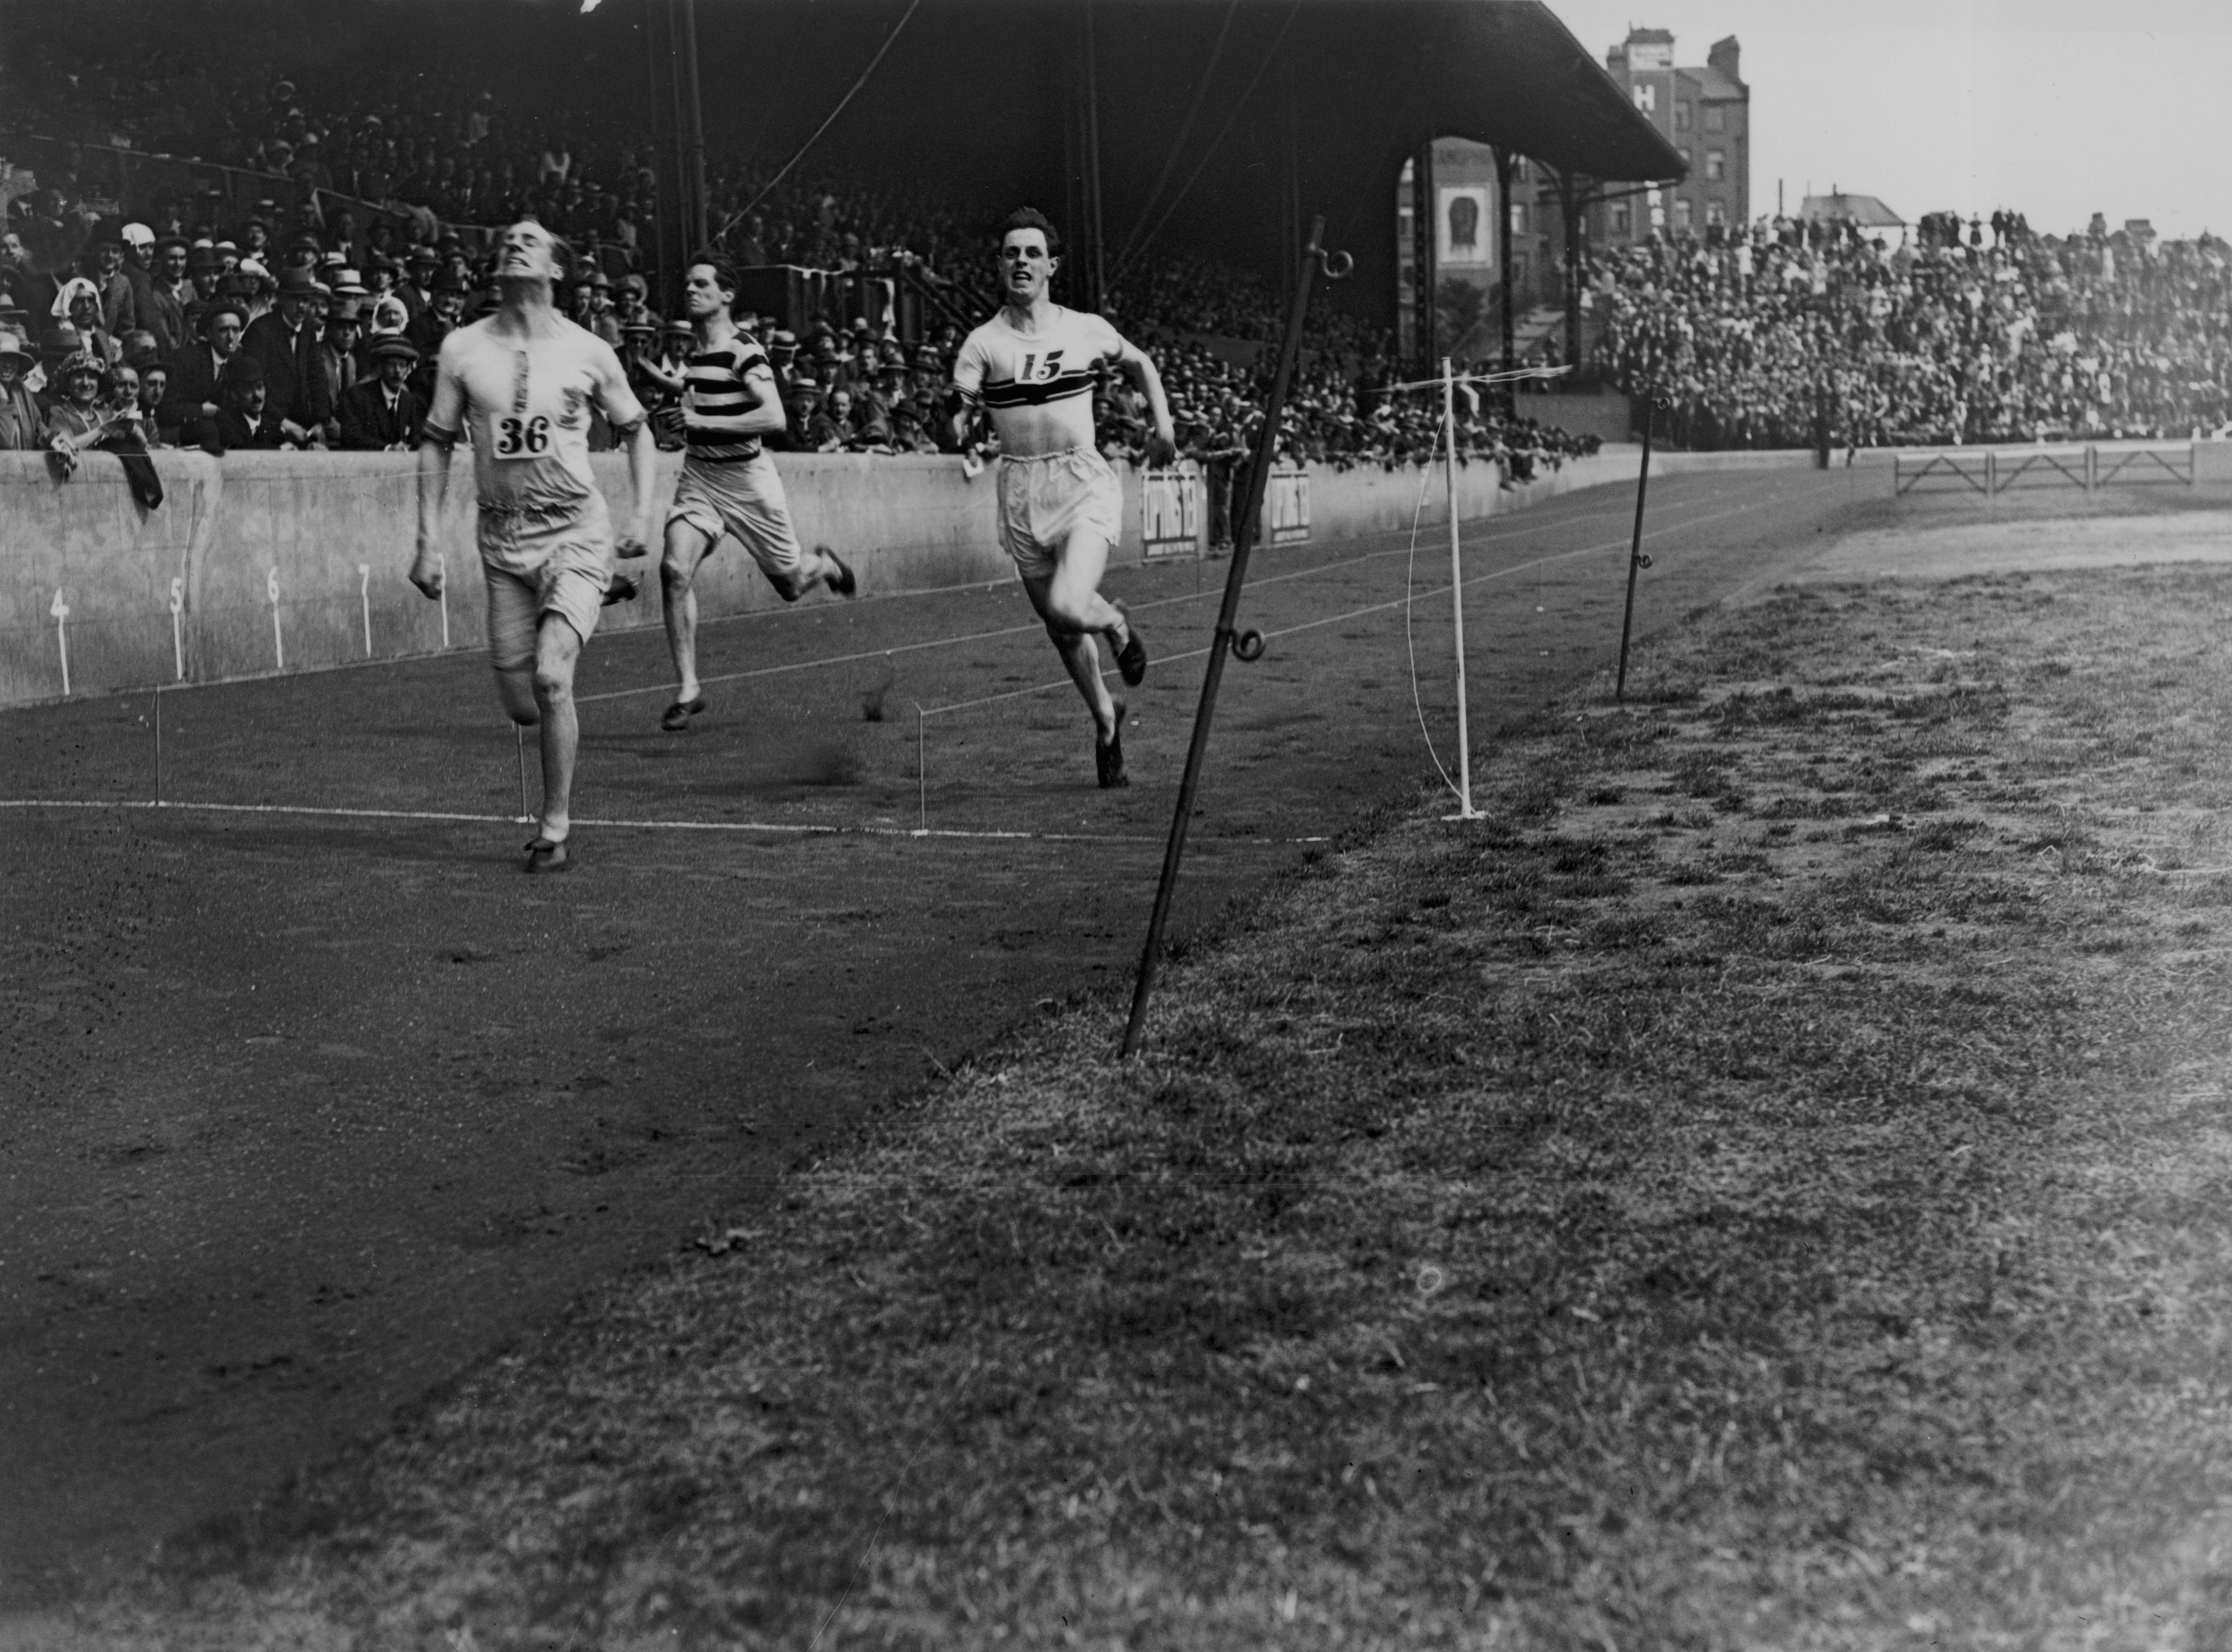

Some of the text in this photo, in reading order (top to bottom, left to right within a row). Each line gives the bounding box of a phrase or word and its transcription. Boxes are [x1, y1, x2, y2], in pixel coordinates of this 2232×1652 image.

[1021, 350, 1064, 380] 15
[498, 416, 549, 455] 36
[170, 577, 181, 614] 5
[267, 566, 280, 603] 6
[358, 564, 370, 596] 7
[50, 587, 70, 617] 4
